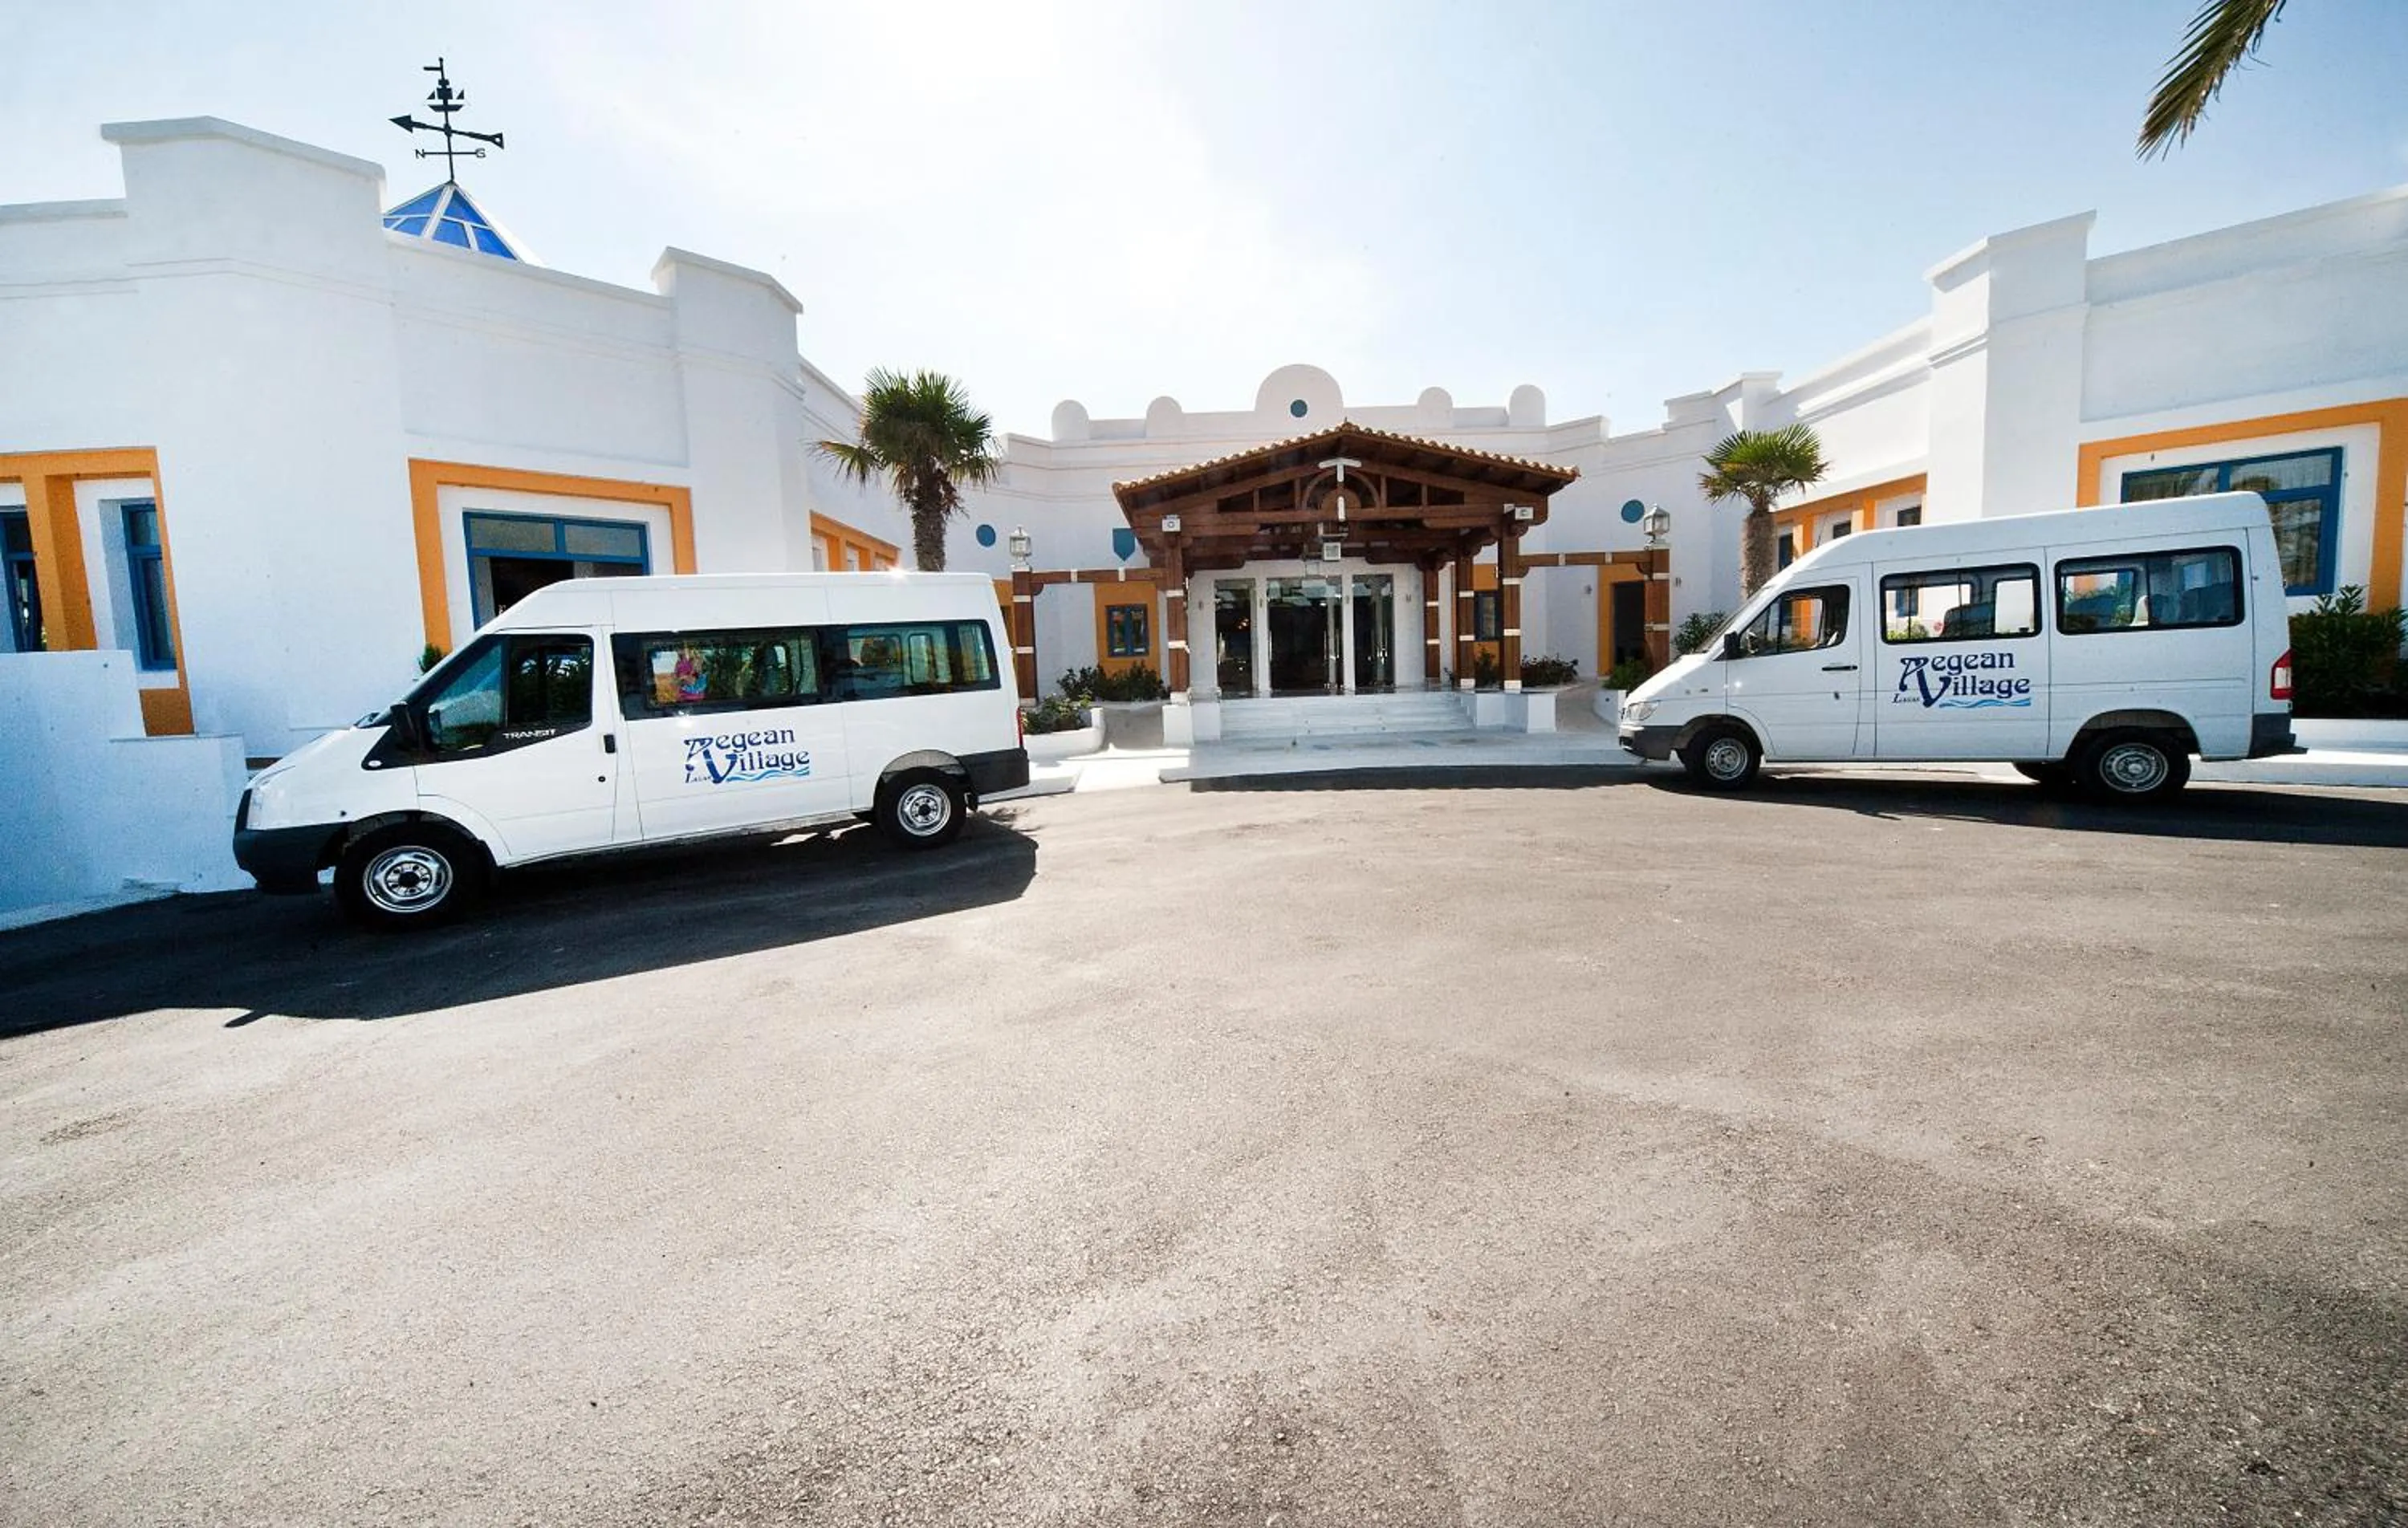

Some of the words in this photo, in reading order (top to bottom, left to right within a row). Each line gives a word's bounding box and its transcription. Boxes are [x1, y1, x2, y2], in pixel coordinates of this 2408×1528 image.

[415, 148, 425, 159] N
[1899, 652, 2015, 691] Aegean
[1917, 674, 2031, 708] Village
[502, 728, 557, 739] TRANSIT
[683, 728, 796, 770] Aegean
[703, 749, 810, 784] Village
